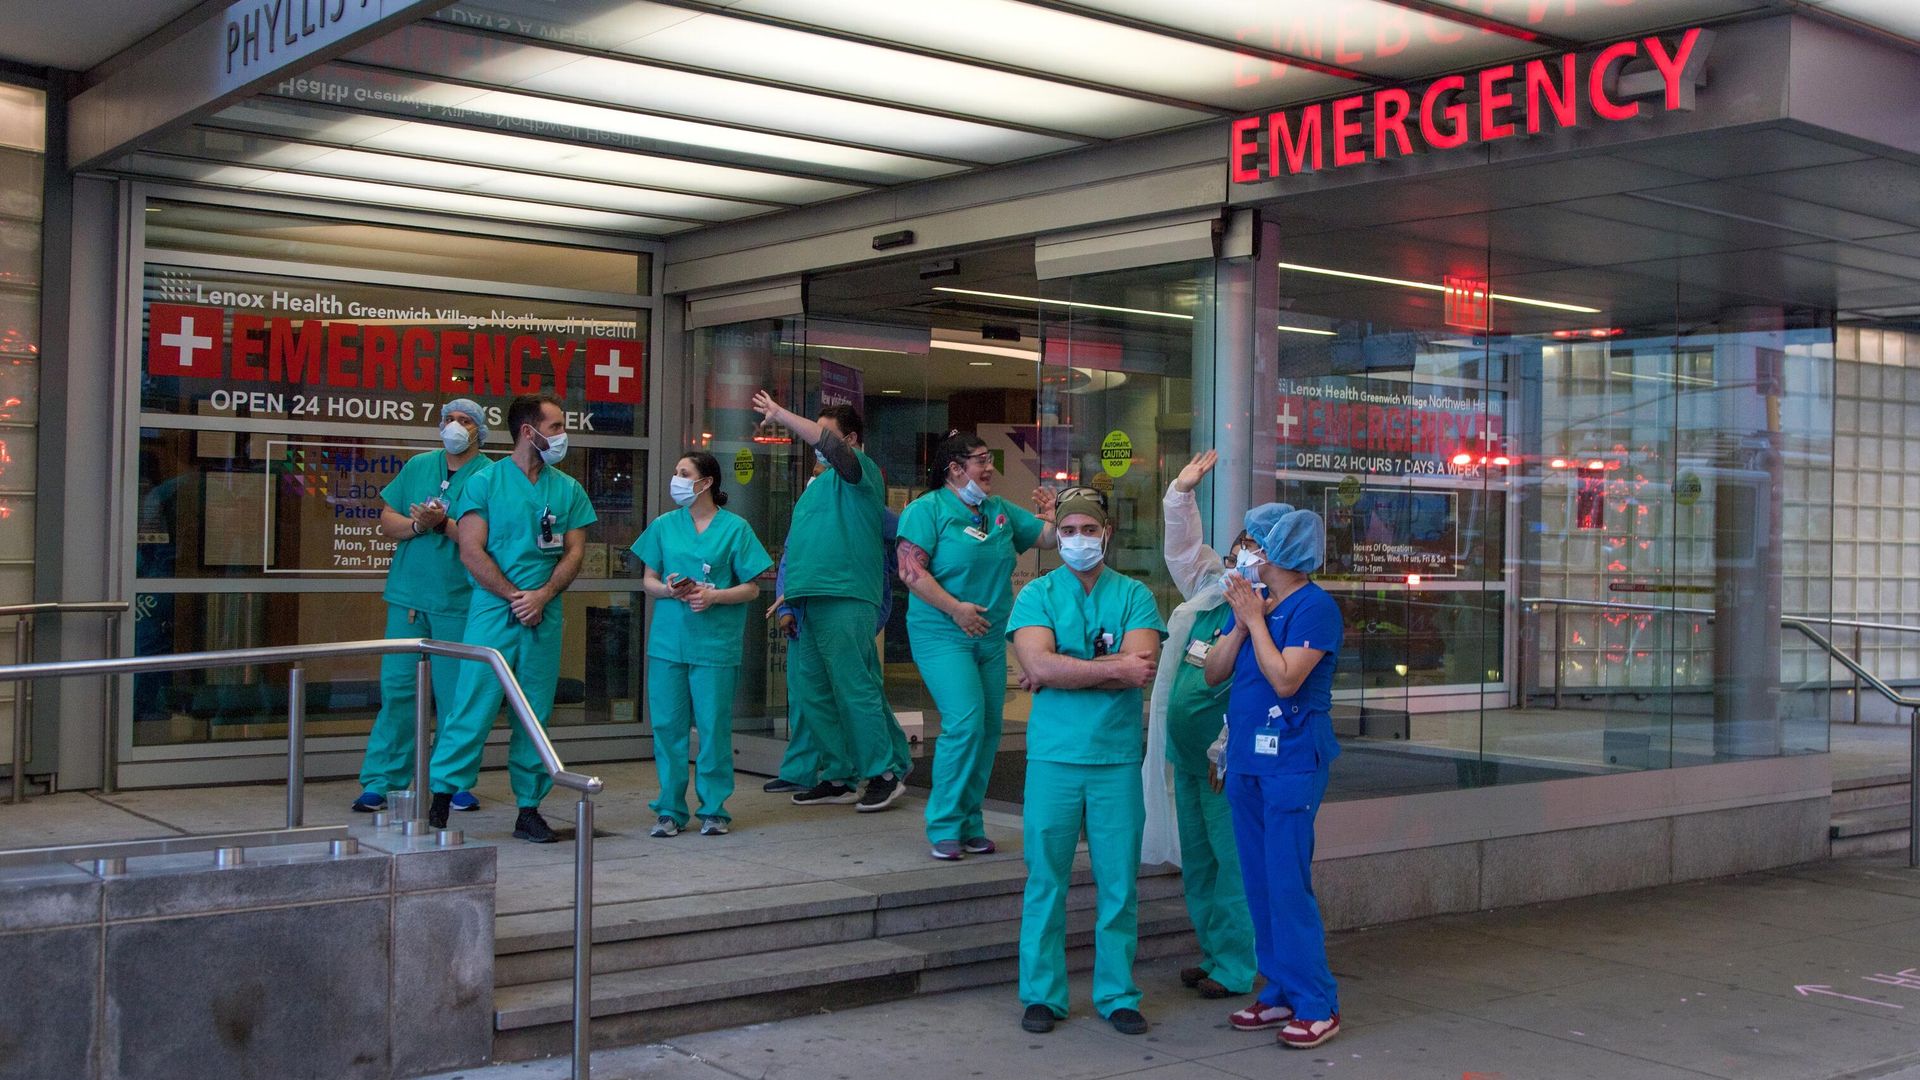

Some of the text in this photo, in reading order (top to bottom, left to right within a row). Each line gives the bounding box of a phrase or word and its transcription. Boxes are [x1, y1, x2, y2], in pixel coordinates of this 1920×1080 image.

[1232, 28, 1702, 184] EMERGENCY
[196, 284, 637, 340] Lenox Health Greenwich Village Northwell Health
[231, 313, 579, 400] EMERGENCY
[1290, 381, 1322, 397] Lenox
[1325, 384, 1359, 401] Health
[1360, 391, 1400, 404] Greenwich
[1402, 393, 1427, 410] Village
[1429, 394, 1471, 411] Northwell
[210, 389, 284, 414] OPEN
[291, 395, 320, 416] 24
[327, 397, 415, 421] HOURS
[422, 402, 435, 422] 7
[561, 411, 594, 431] EK
[1307, 399, 1473, 457] EMERGENCY
[335, 451, 405, 473] North
[1103, 449, 1131, 459] CAUTION
[1296, 452, 1480, 477] OPEN 24 HOURS 7 DAYS A WEEK
[334, 523, 373, 536] Hours
[334, 538, 366, 552] Mon,
[1353, 543, 1413, 554] Hours Of Operation
[333, 554, 393, 569] 7am-1pm
